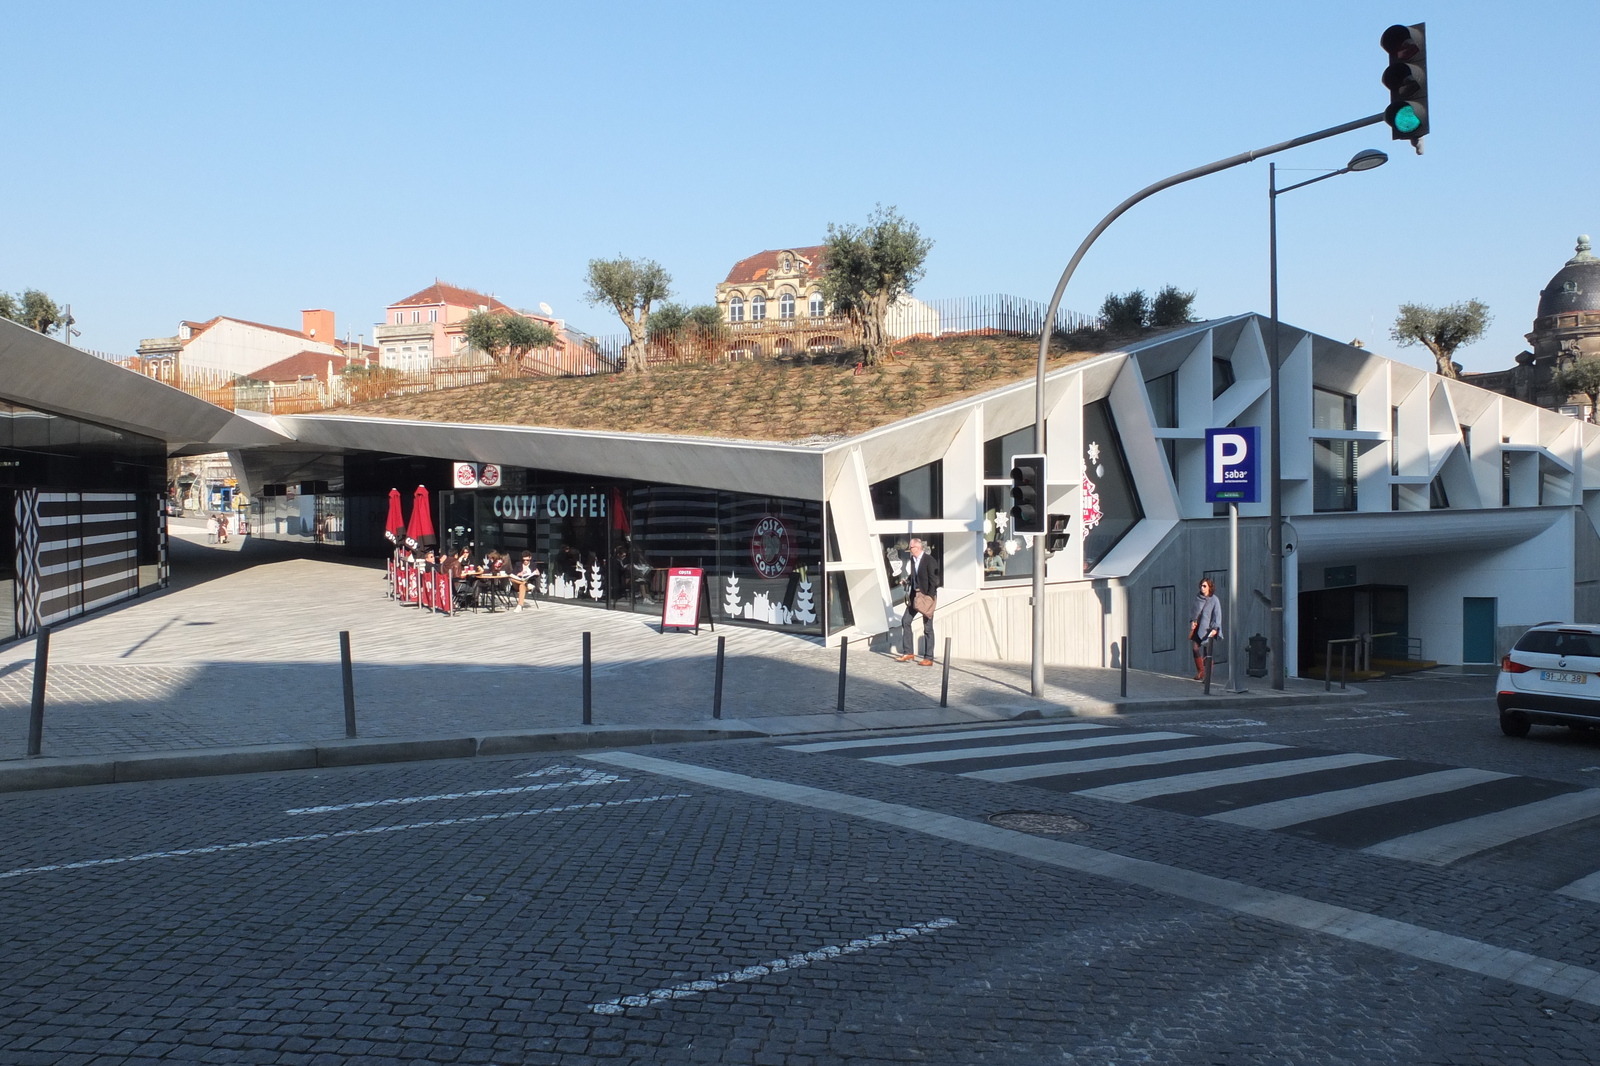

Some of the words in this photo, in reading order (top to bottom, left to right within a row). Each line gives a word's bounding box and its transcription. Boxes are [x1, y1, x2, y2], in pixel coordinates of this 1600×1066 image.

[1213, 434, 1247, 483] P
[1224, 469, 1245, 478] saba
[494, 495, 537, 520] COSTA
[547, 494, 605, 517] COFFEE
[757, 520, 783, 538] COSTA
[755, 554, 786, 575] COFFEE
